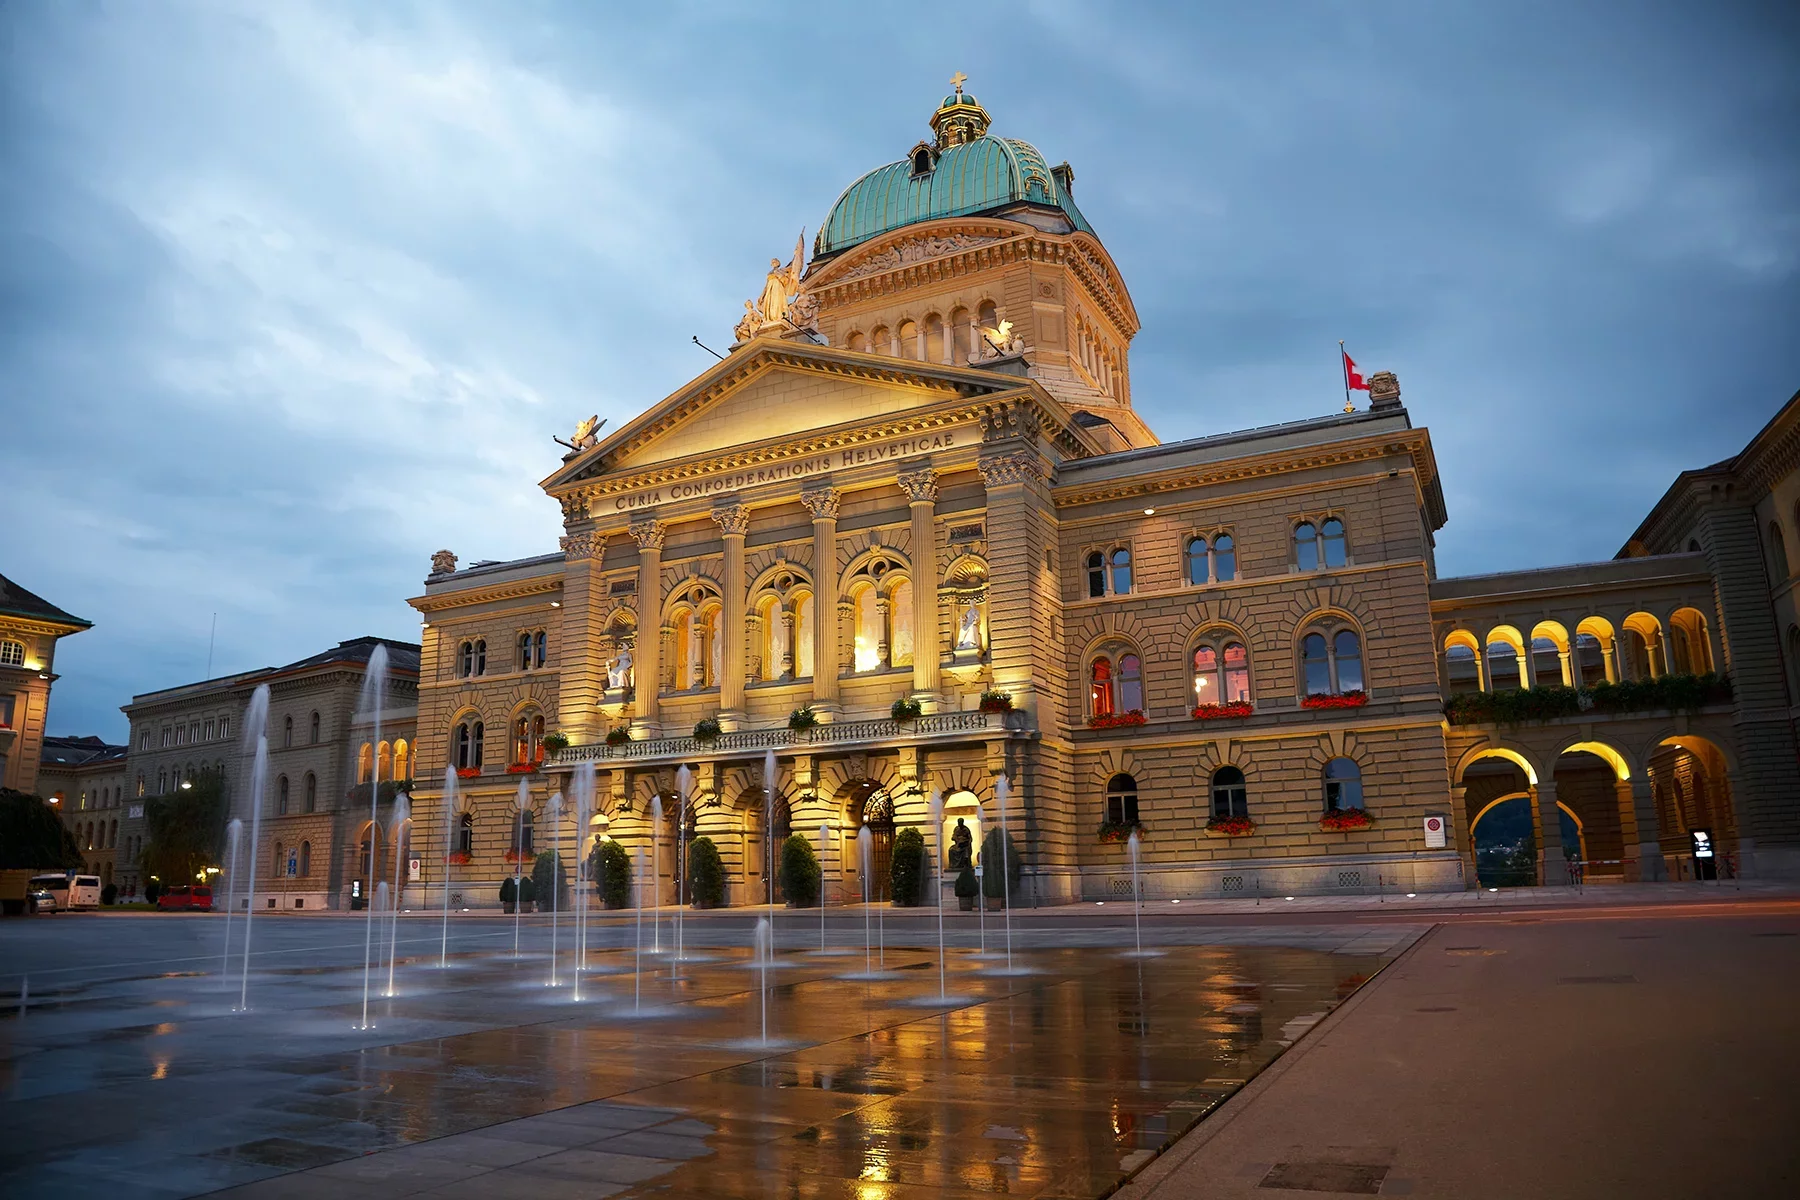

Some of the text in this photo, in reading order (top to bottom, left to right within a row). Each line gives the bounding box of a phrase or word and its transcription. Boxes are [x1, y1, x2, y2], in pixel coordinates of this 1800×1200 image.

[615, 434, 954, 510] CURIA CONFOEDERATIONIS HELVETICAE
